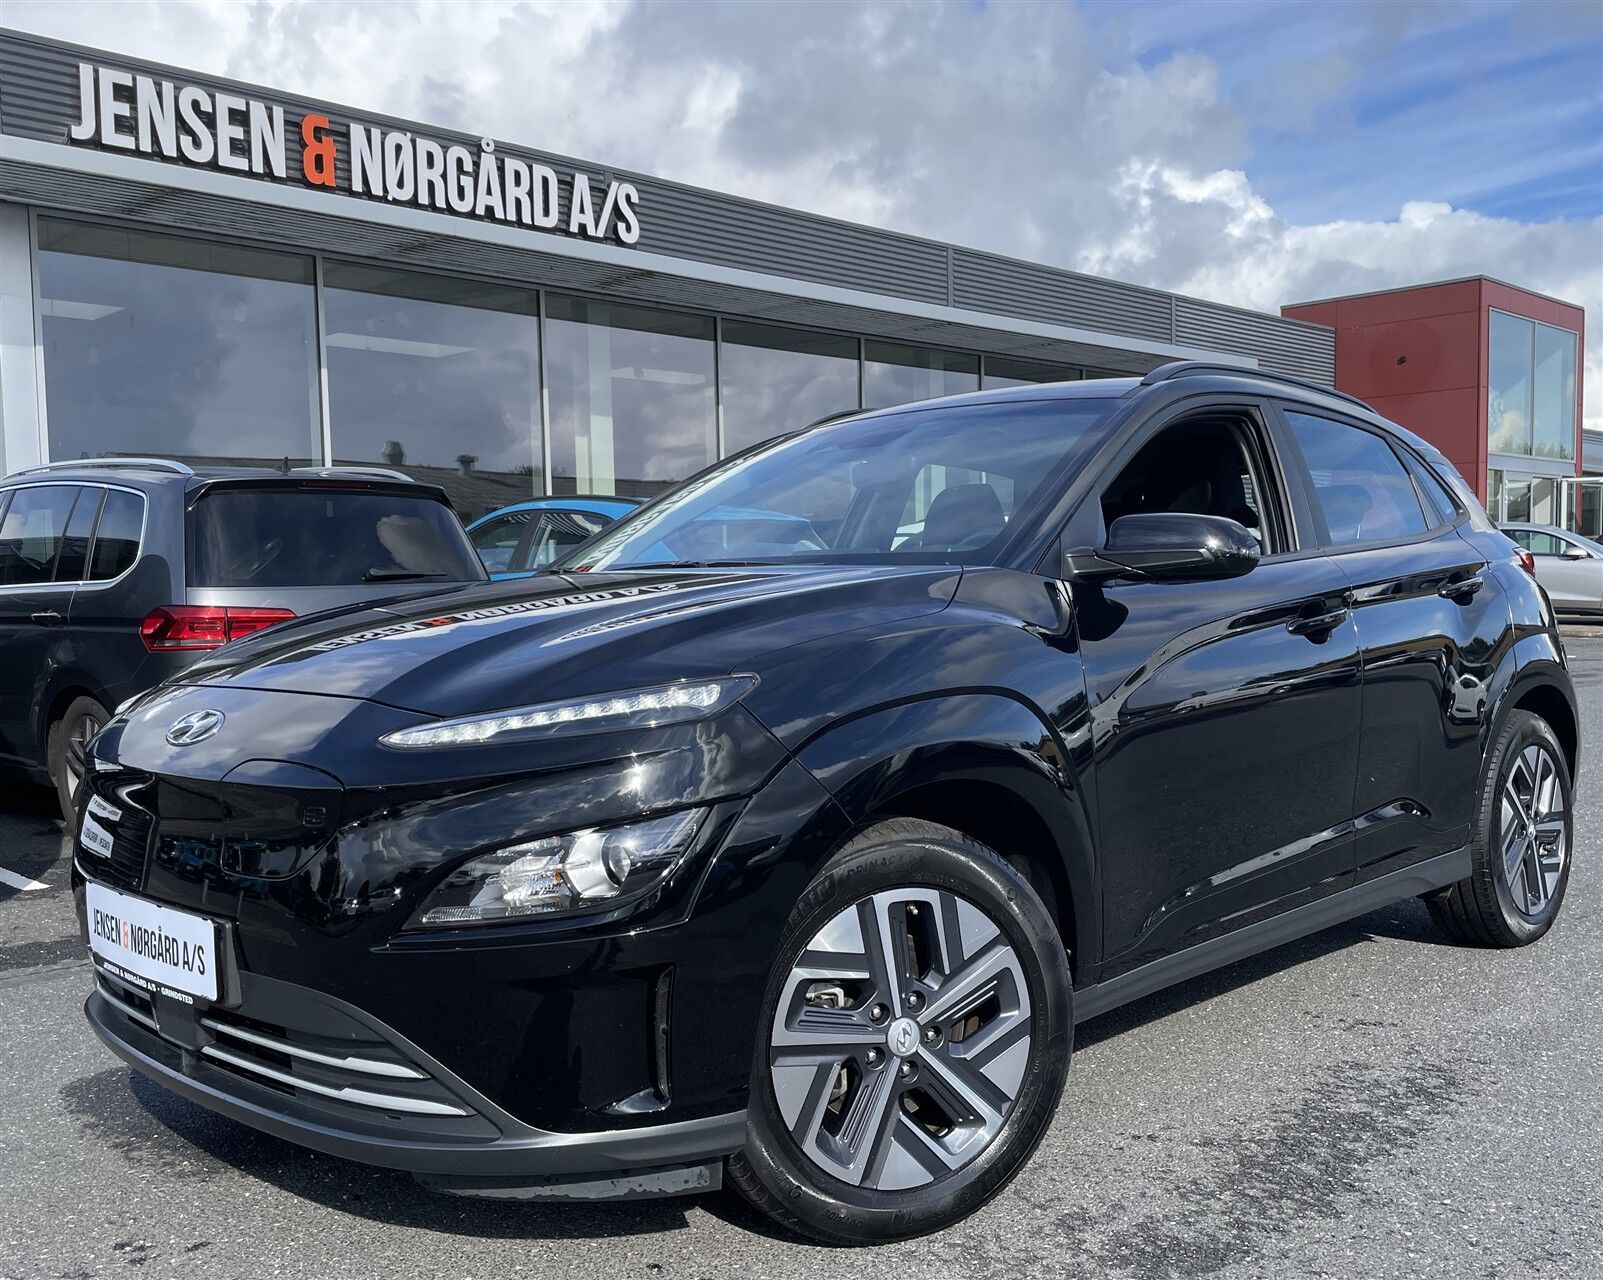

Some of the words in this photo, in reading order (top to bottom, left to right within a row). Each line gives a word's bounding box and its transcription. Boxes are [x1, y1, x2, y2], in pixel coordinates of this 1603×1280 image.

[71, 62, 286, 178] JENSEN
[302, 113, 336, 187] &
[350, 122, 559, 228] NØRGÅRD
[569, 173, 640, 244] A/S
[93, 907, 121, 946] JENSEN
[121, 923, 128, 951] &
[130, 923, 179, 967] NØRGÅRD
[182, 940, 206, 976] A/S
[161, 986, 194, 1005] GRINDSTED
